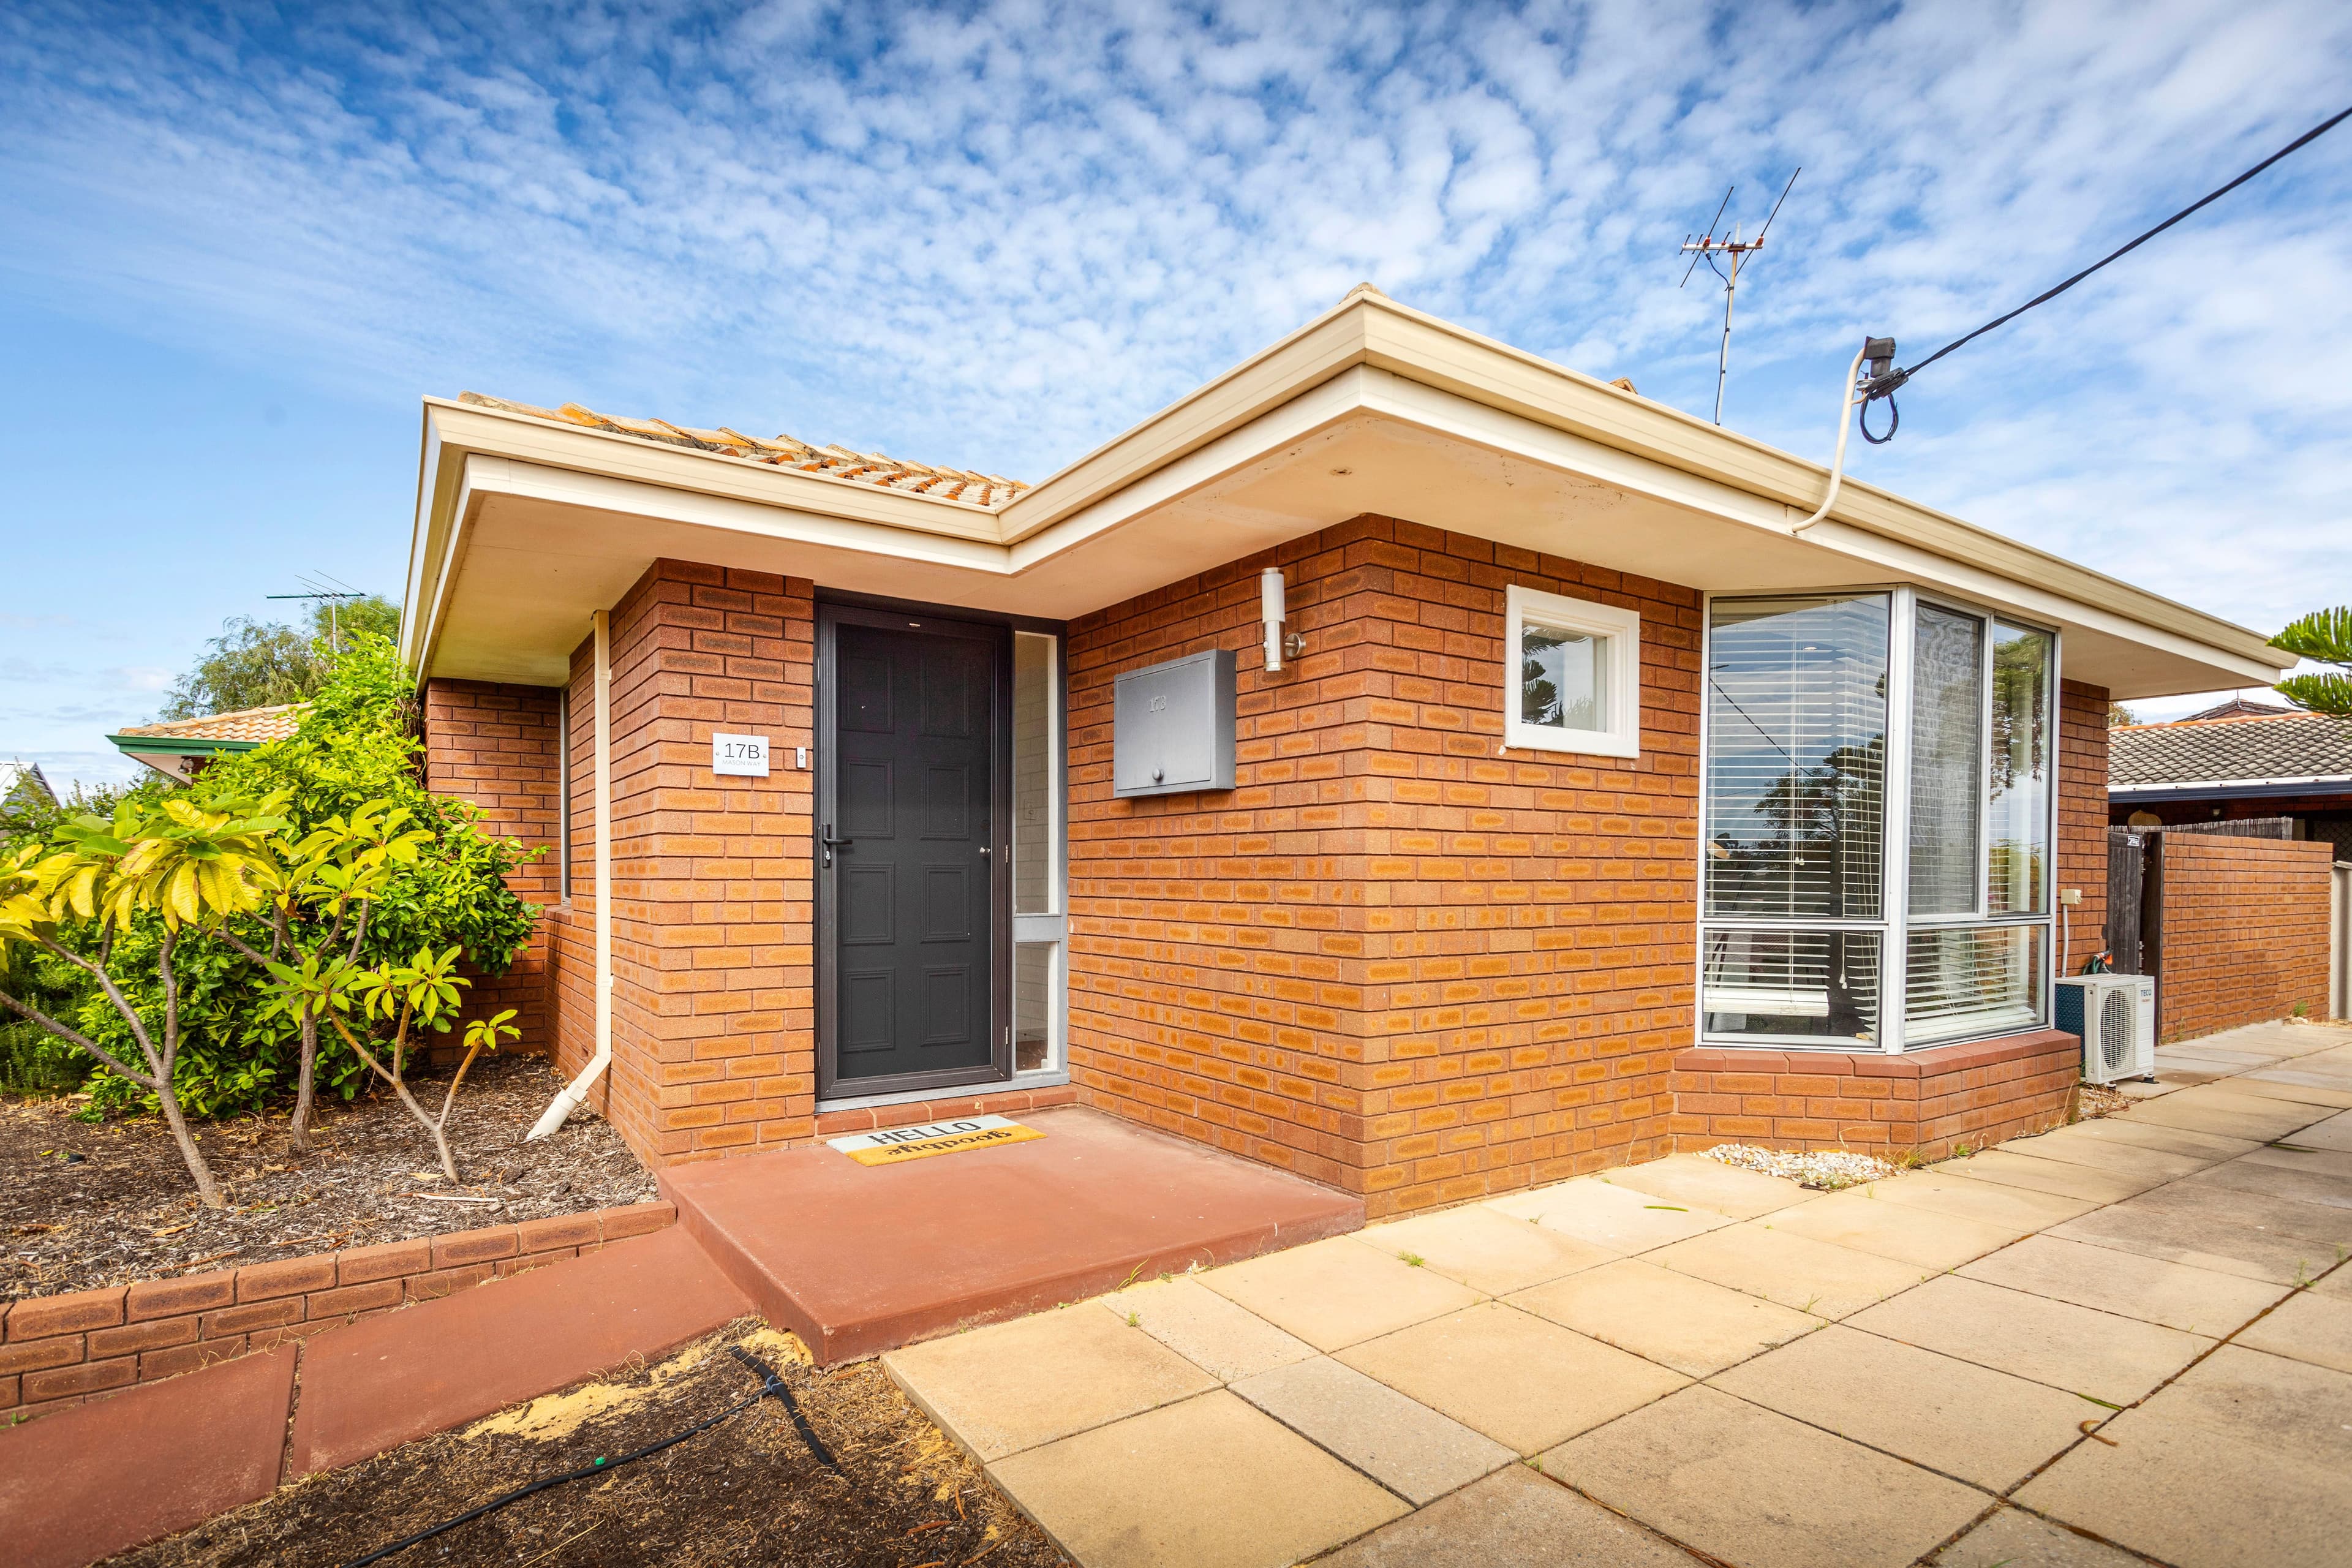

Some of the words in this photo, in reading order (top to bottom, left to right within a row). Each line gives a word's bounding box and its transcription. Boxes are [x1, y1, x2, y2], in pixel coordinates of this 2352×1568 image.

[1149, 696, 1166, 712] 17B
[725, 743, 760, 759] 17B
[867, 1122, 981, 1145] HELLO
[884, 1131, 1012, 1155] goodbye
